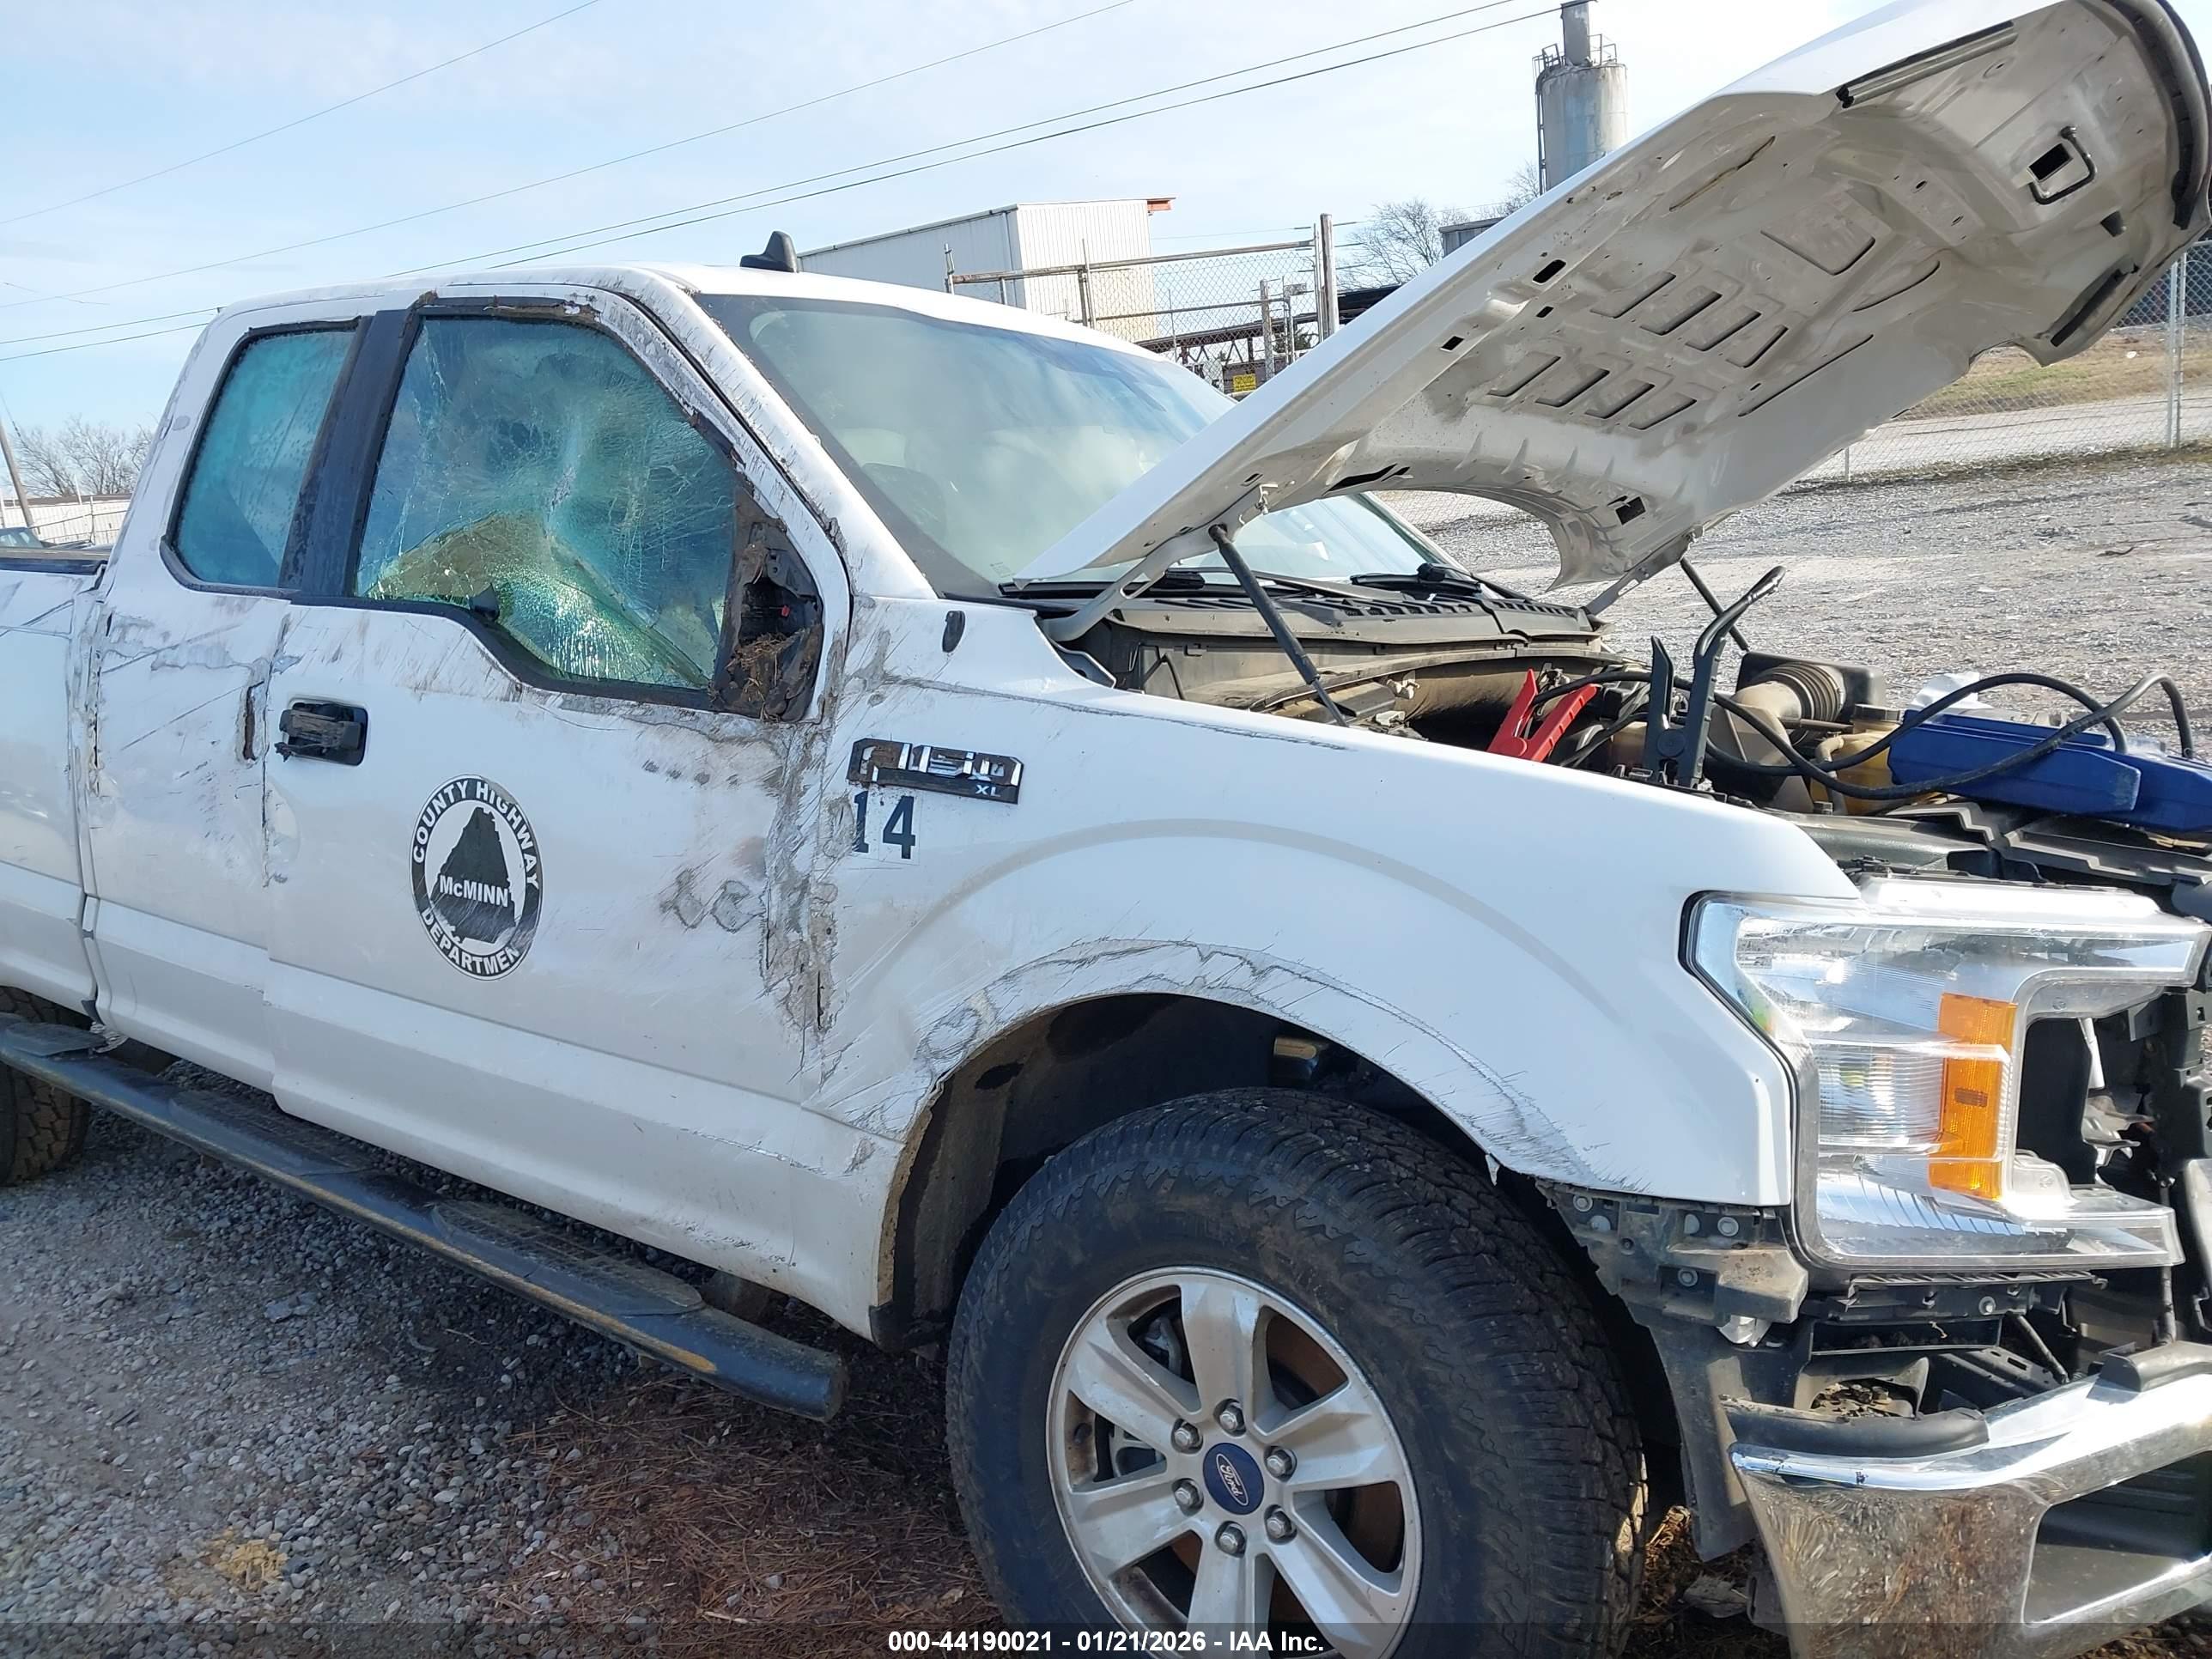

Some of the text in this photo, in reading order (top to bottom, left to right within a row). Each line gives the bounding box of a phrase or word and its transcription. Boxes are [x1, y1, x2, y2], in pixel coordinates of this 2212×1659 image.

[975, 784, 1002, 798] XL
[413, 780, 539, 890] COUNTY HIGHWAY
[852, 790, 916, 860] 14
[439, 874, 508, 908] McMINN
[421, 909, 522, 975] DEPARTMEN
[1219, 1463, 1243, 1497] Ford
